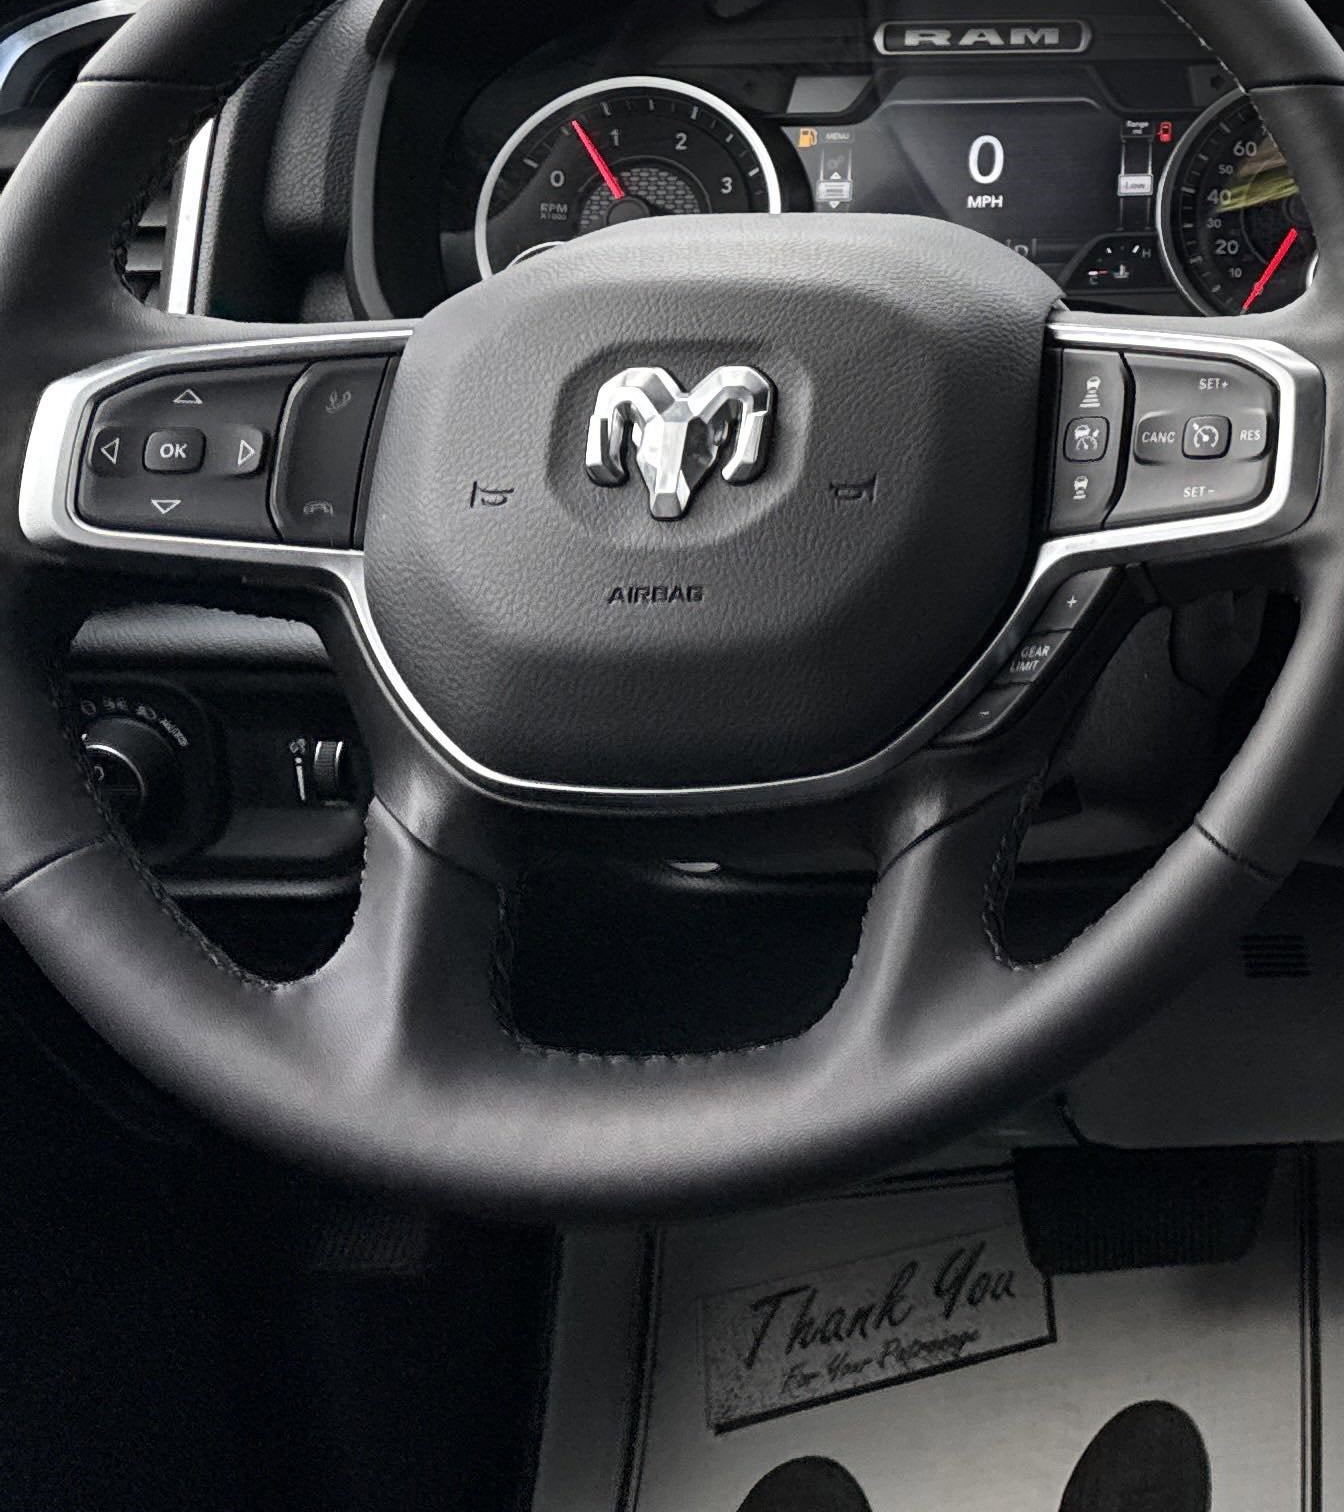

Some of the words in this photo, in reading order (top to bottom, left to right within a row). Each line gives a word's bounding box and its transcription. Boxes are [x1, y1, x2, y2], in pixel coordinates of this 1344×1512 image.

[904, 26, 1060, 47] RAM
[610, 130, 620, 146] 1
[675, 132, 688, 150] 2
[1233, 141, 1257, 157] 60
[967, 134, 1005, 186] 0
[1218, 164, 1234, 175] 50
[550, 170, 564, 187] 0
[721, 177, 733, 195] 3
[966, 195, 1003, 209] MPH
[1208, 189, 1231, 205] 40
[539, 203, 568, 214] RPM
[1206, 218, 1222, 229] 30
[1215, 240, 1239, 255] 20
[1228, 268, 1242, 277] 10
[1142, 430, 1175, 444] CANC
[1240, 430, 1261, 442] RES
[159, 442, 188, 459] OK
[607, 585, 704, 605] AIRBAG
[1020, 645, 1050, 658] GEAR
[1010, 659, 1040, 673] LIMIT
[744, 1259, 919, 1369] Thank
[932, 1240, 1016, 1319] You
[782, 1367, 819, 1394] For
[827, 1354, 874, 1383] Your
